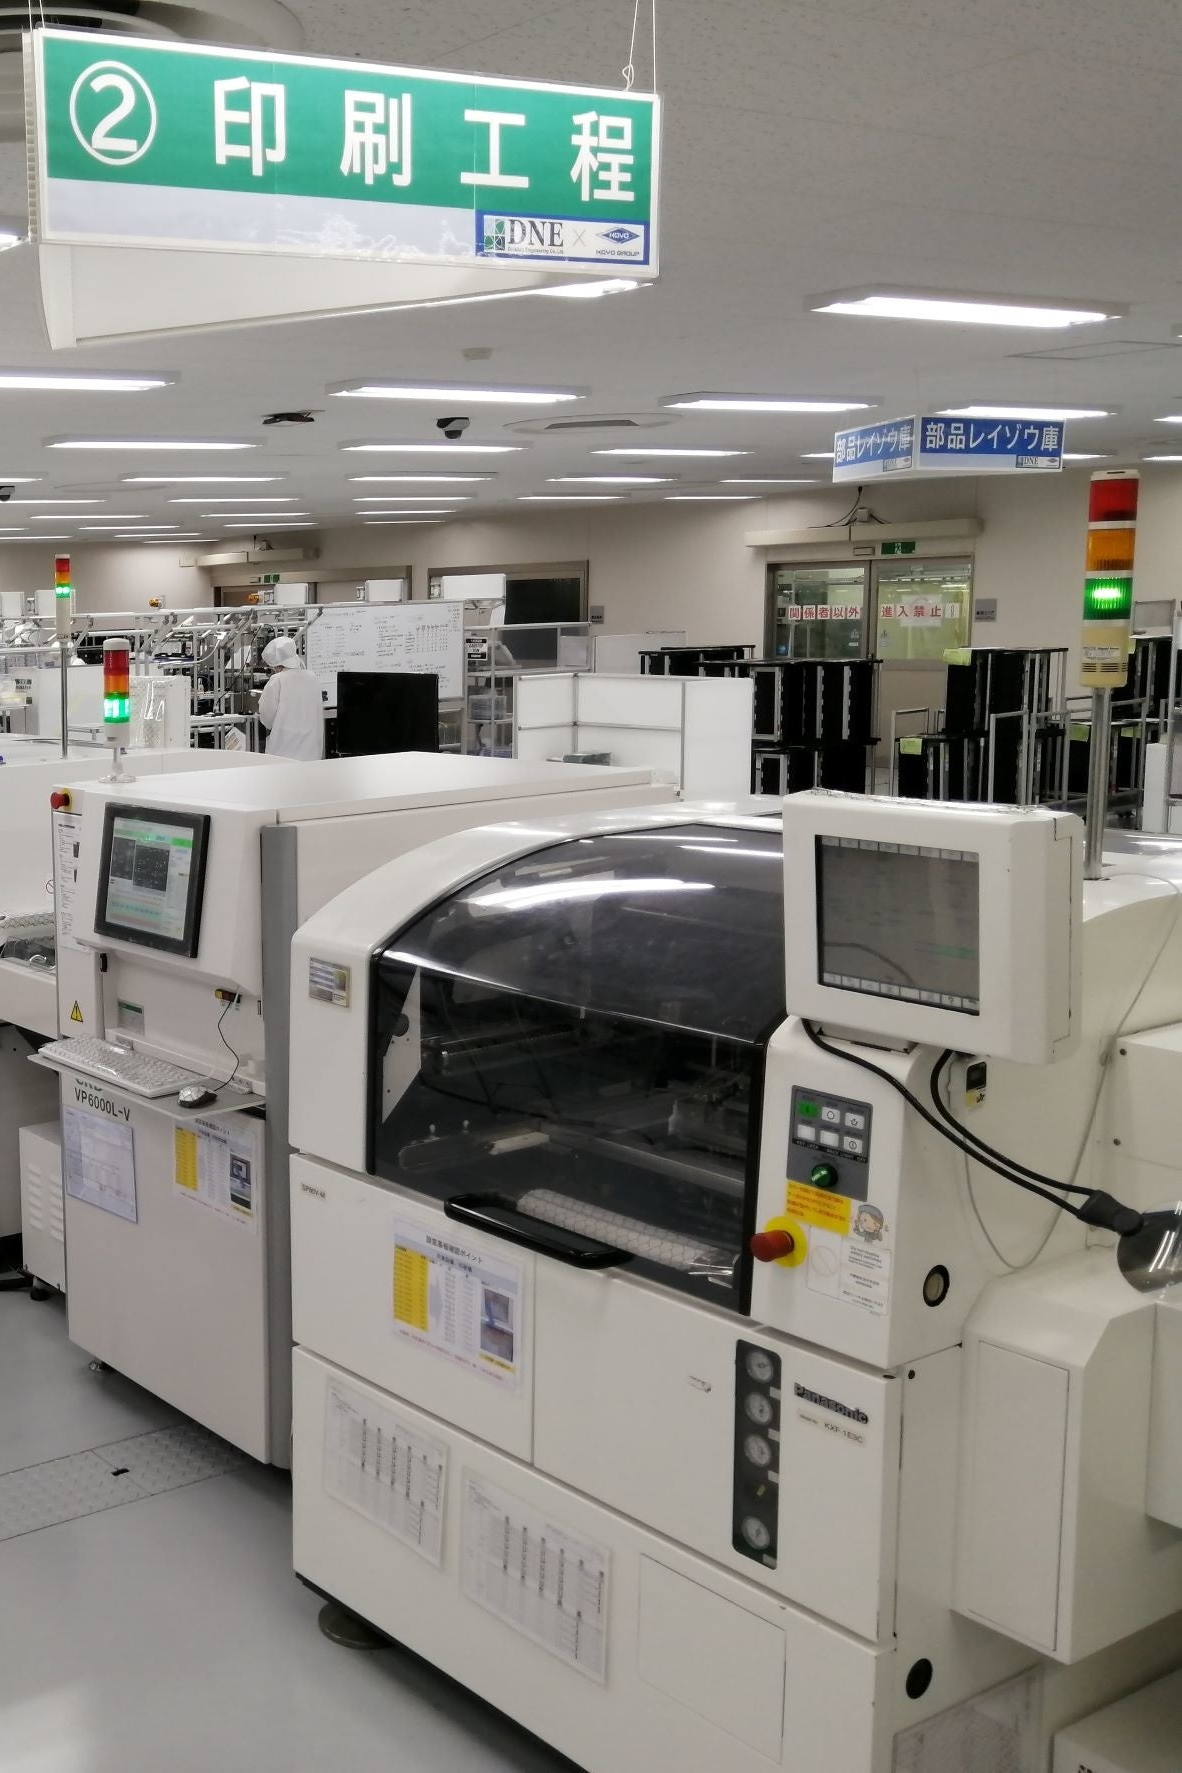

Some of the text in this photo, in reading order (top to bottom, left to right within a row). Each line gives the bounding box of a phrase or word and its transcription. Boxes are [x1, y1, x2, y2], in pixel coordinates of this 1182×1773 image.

[508, 219, 563, 247] DNE
[835, 425, 912, 463] 部品レイゾウ庫
[926, 422, 1059, 452] 部品レイゾウ庫
[789, 605, 942, 619] 関係者以外 進入禁止
[75, 1087, 130, 1121] VP6000L-V
[794, 1382, 868, 1424] Panasonic
